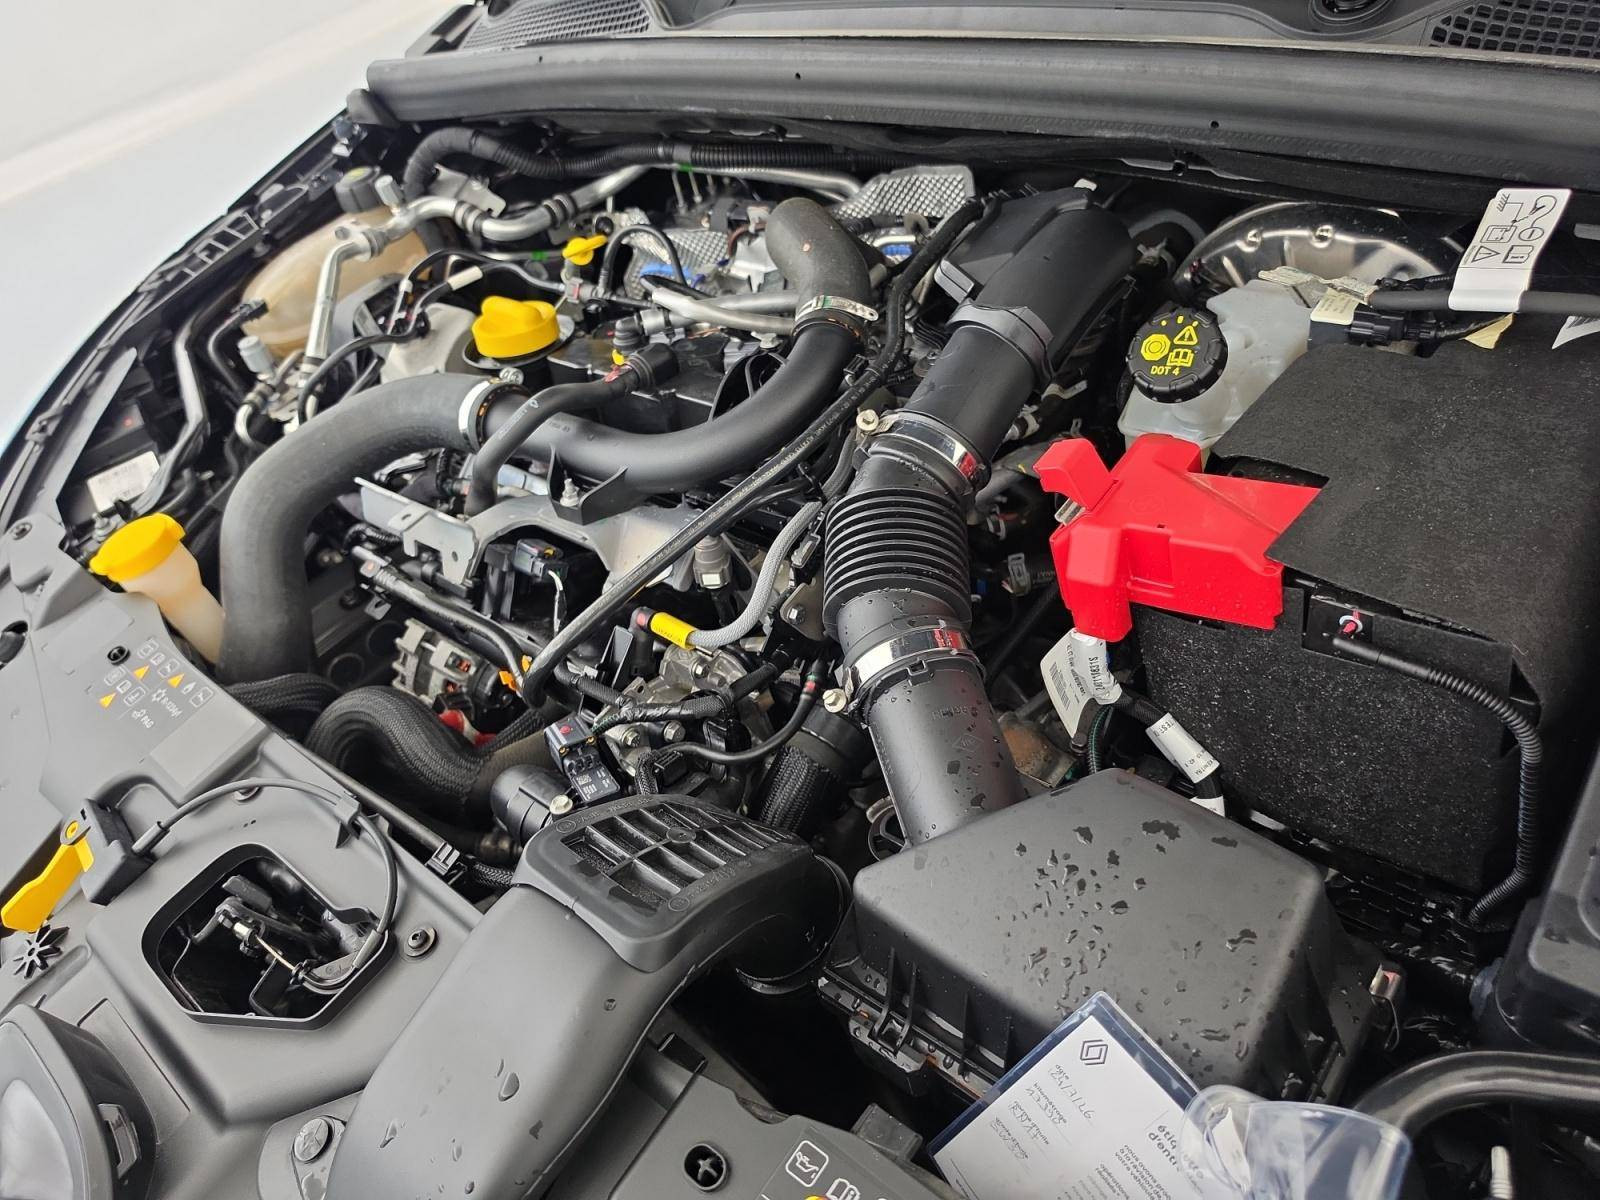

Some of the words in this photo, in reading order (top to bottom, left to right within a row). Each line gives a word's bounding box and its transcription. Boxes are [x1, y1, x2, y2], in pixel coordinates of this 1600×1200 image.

[1150, 365, 1171, 376] DOT
[1172, 366, 1180, 376] 4
[1055, 1064, 1069, 1080] date
[1115, 1152, 1131, 1172] votre
[1123, 1144, 1139, 1162] nous
[1138, 1160, 1157, 1184] avons
[1129, 1160, 1154, 1190] révision
